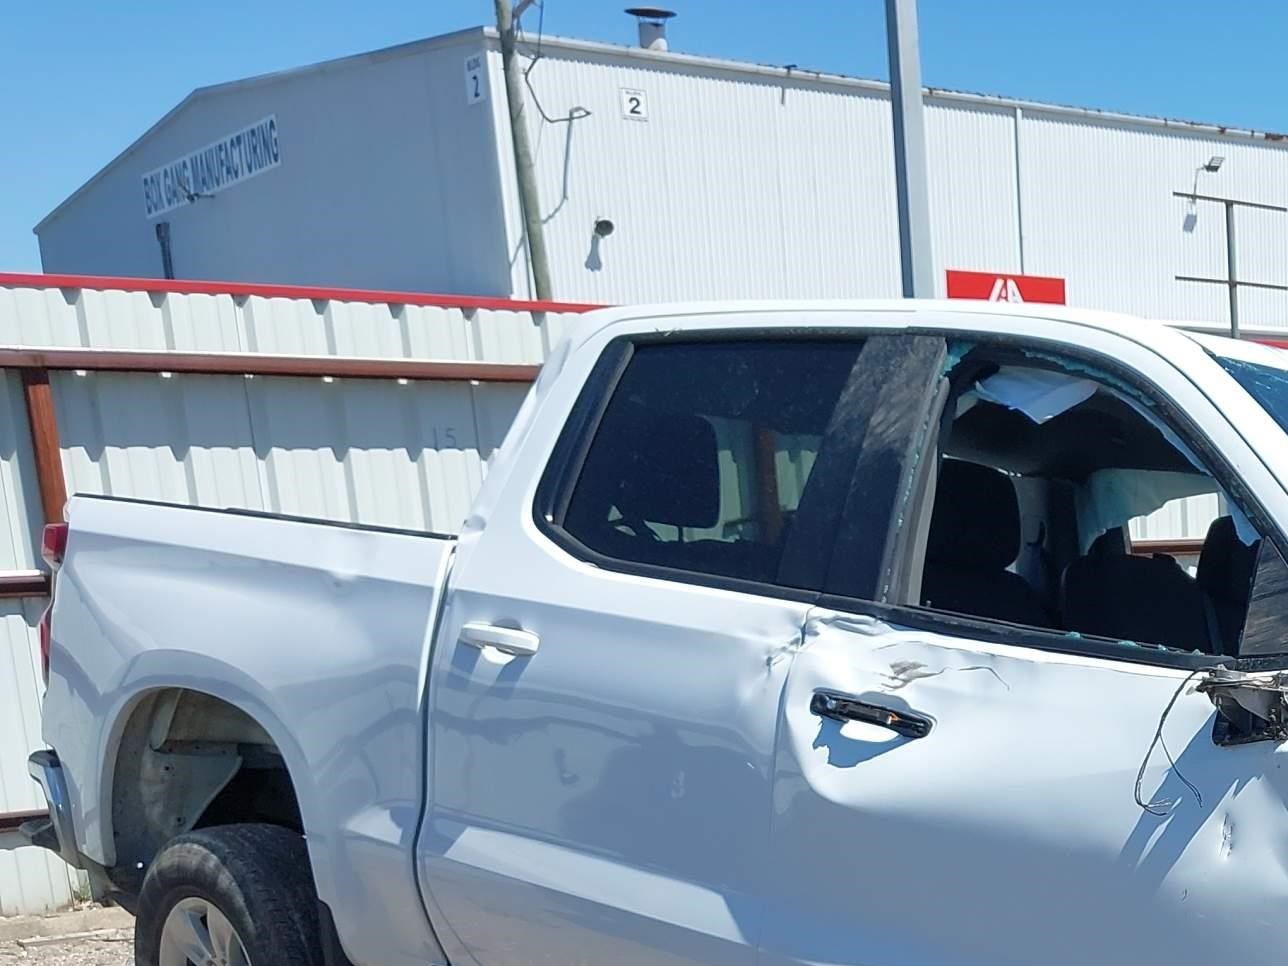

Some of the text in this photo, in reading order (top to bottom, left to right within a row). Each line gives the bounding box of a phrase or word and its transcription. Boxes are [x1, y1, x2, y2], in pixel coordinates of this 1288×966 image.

[472, 75, 481, 97] 2
[628, 96, 642, 115] 2
[143, 171, 166, 215] BOX
[190, 119, 280, 194] MANUFACTURING
